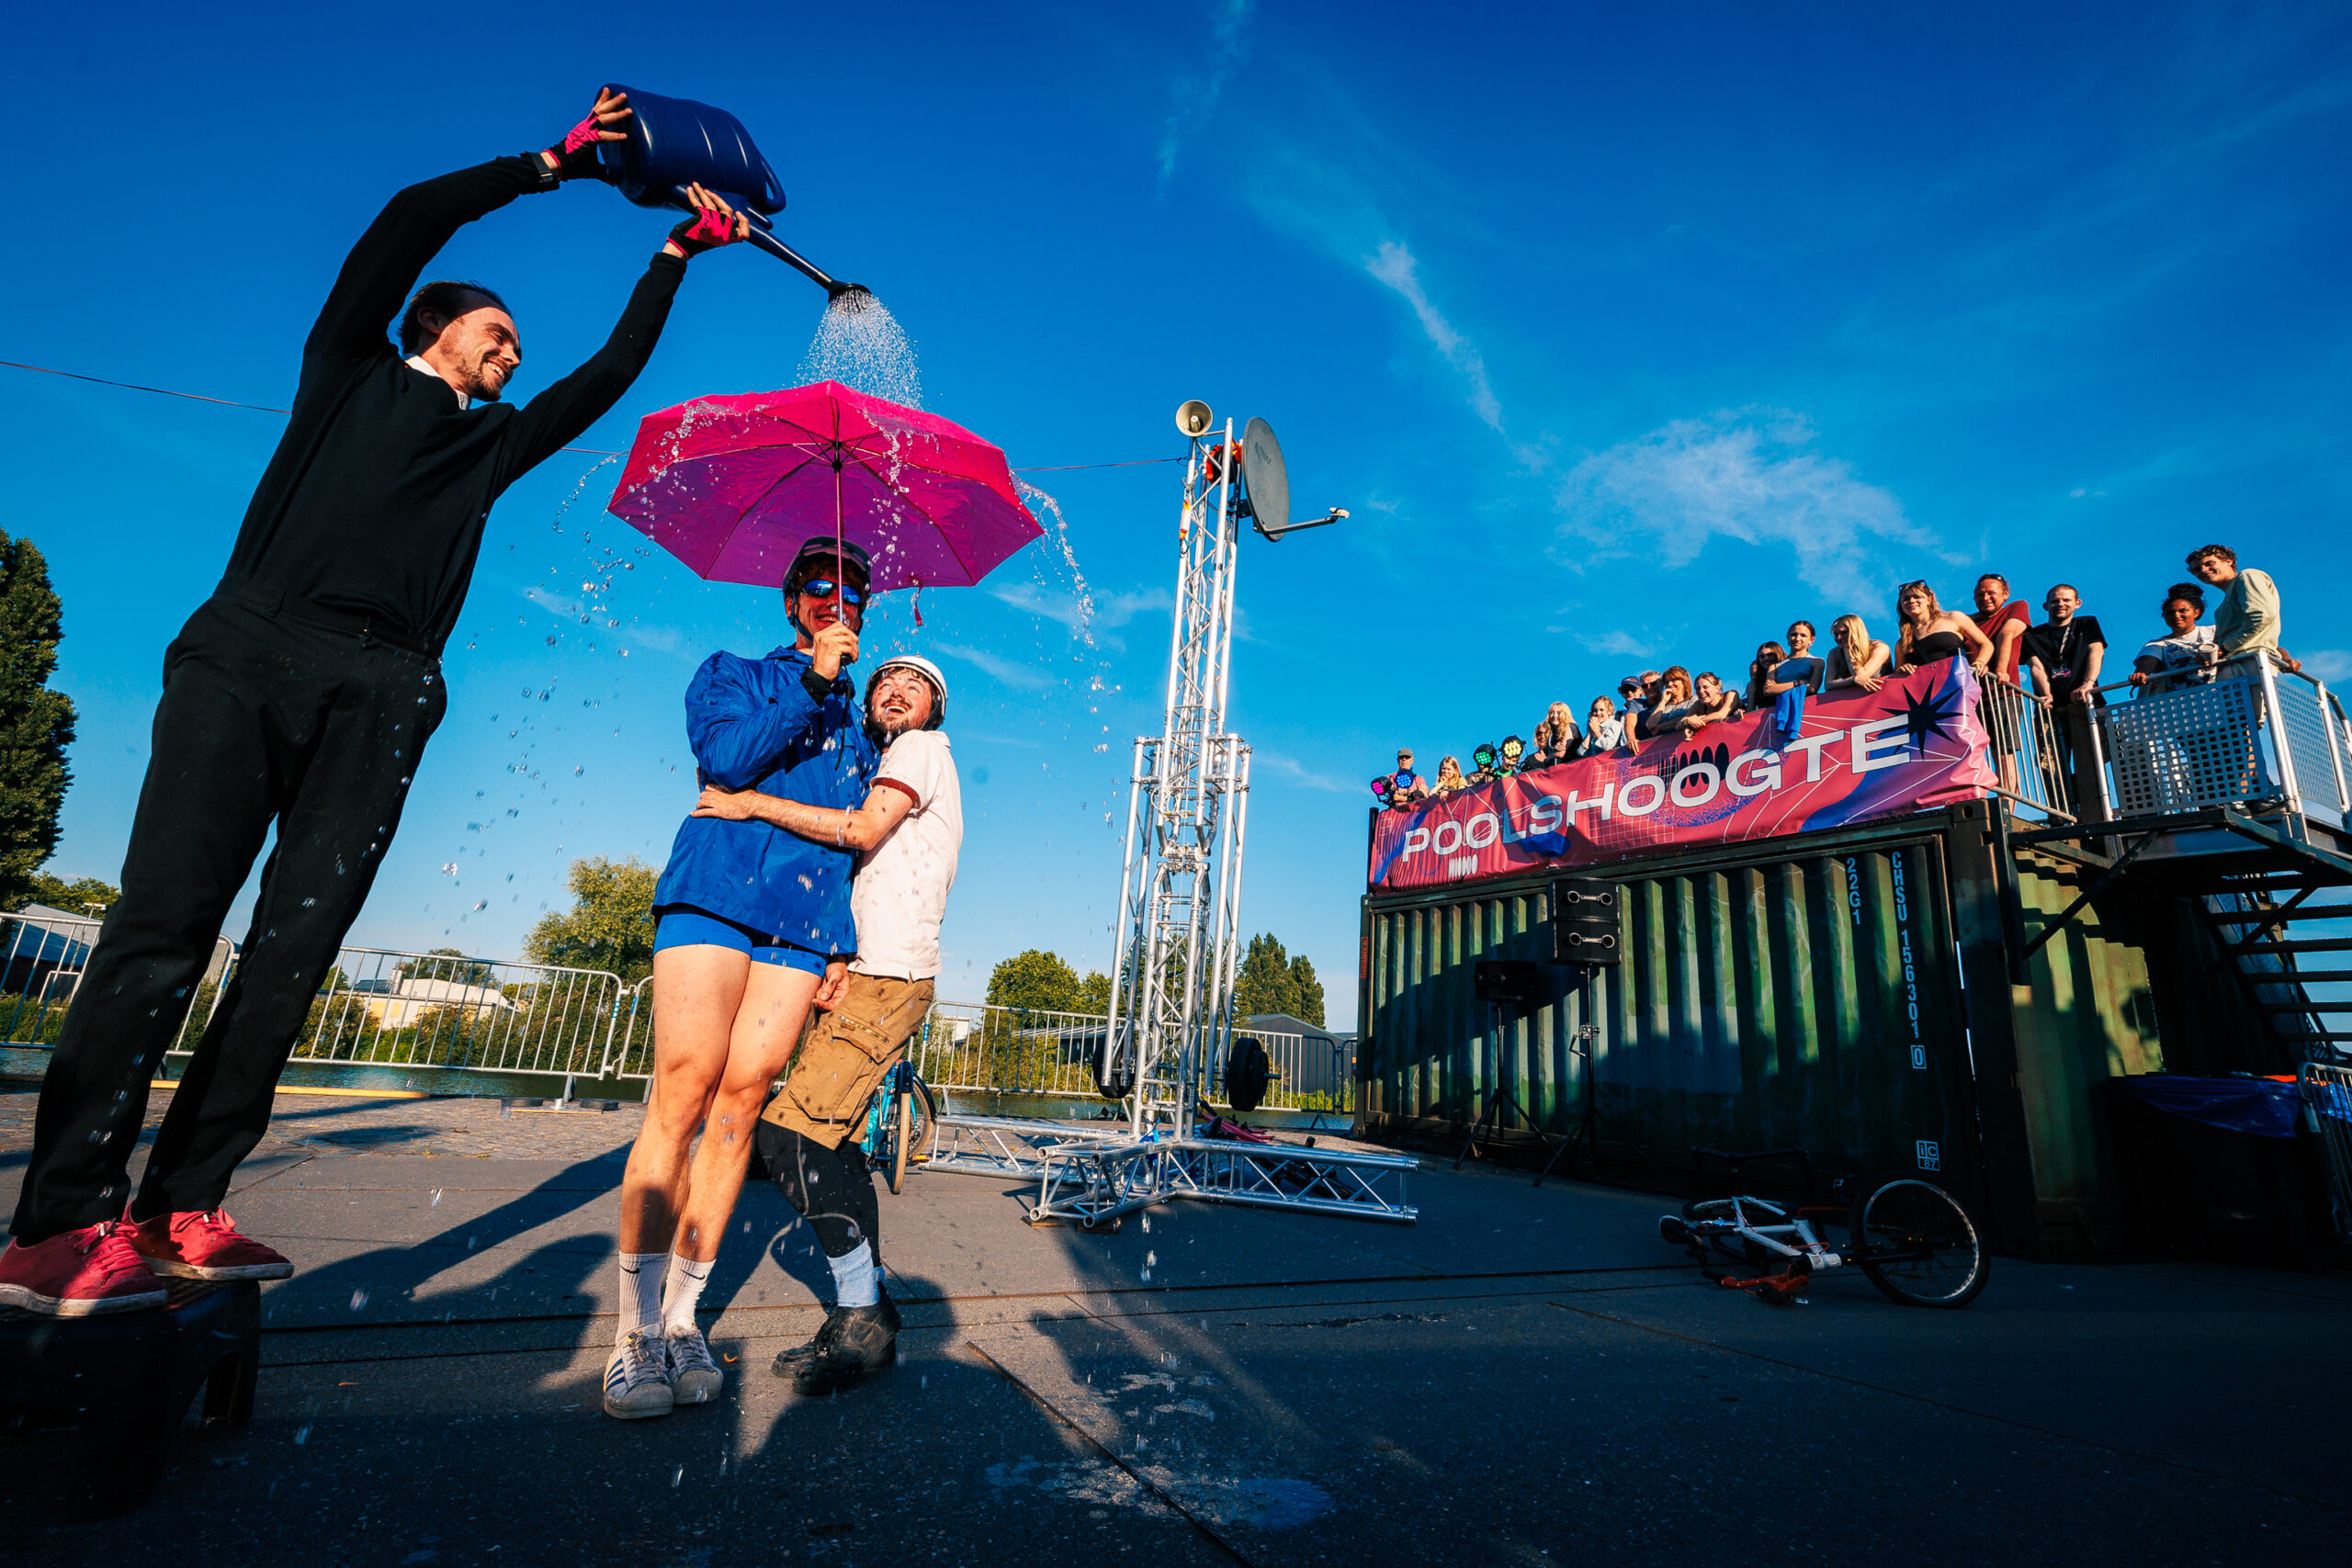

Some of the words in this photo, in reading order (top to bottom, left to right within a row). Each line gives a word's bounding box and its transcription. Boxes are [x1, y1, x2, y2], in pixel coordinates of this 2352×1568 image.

[1401, 713, 1911, 863] POOLSHOOGTE
[1846, 856, 1861, 925] 22G1
[1892, 851, 1908, 922] CHSU
[1901, 929, 1920, 1040] 156301
